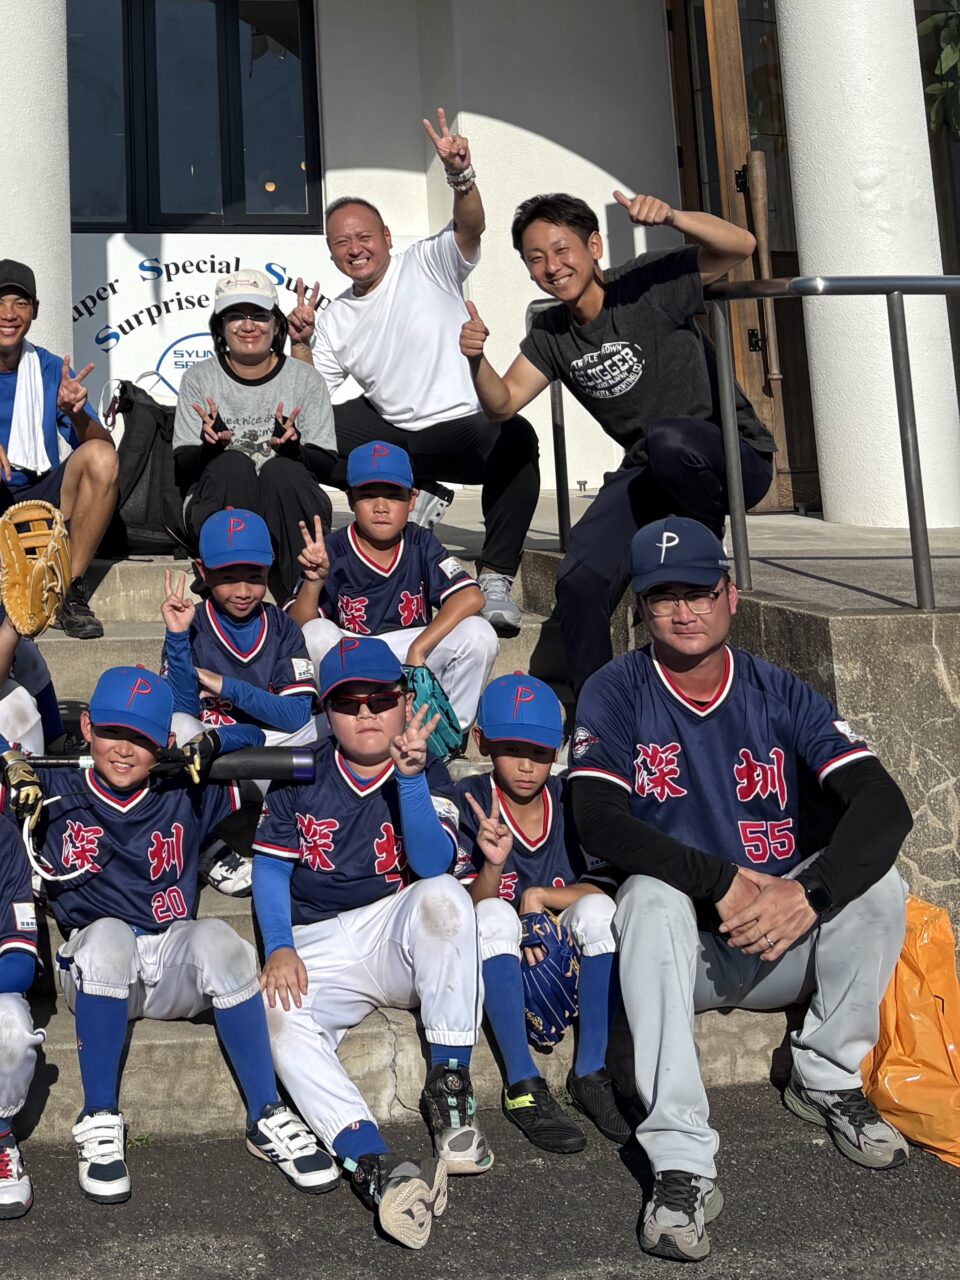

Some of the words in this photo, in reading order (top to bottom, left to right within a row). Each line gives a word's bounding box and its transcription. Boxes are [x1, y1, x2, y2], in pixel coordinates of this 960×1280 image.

[71, 278, 120, 323] uper
[138, 254, 241, 283] Special
[94, 291, 210, 354] Surprise
[173, 350, 216, 358] SYUN
[574, 347, 638, 387] SLUGGER
[371, 445, 389, 469] P
[224, 517, 245, 548] P
[655, 531, 679, 563] P
[337, 637, 359, 671] P
[126, 677, 152, 708] P
[513, 686, 535, 719] P
[738, 820, 796, 863] 55
[151, 886, 187, 924] 20
